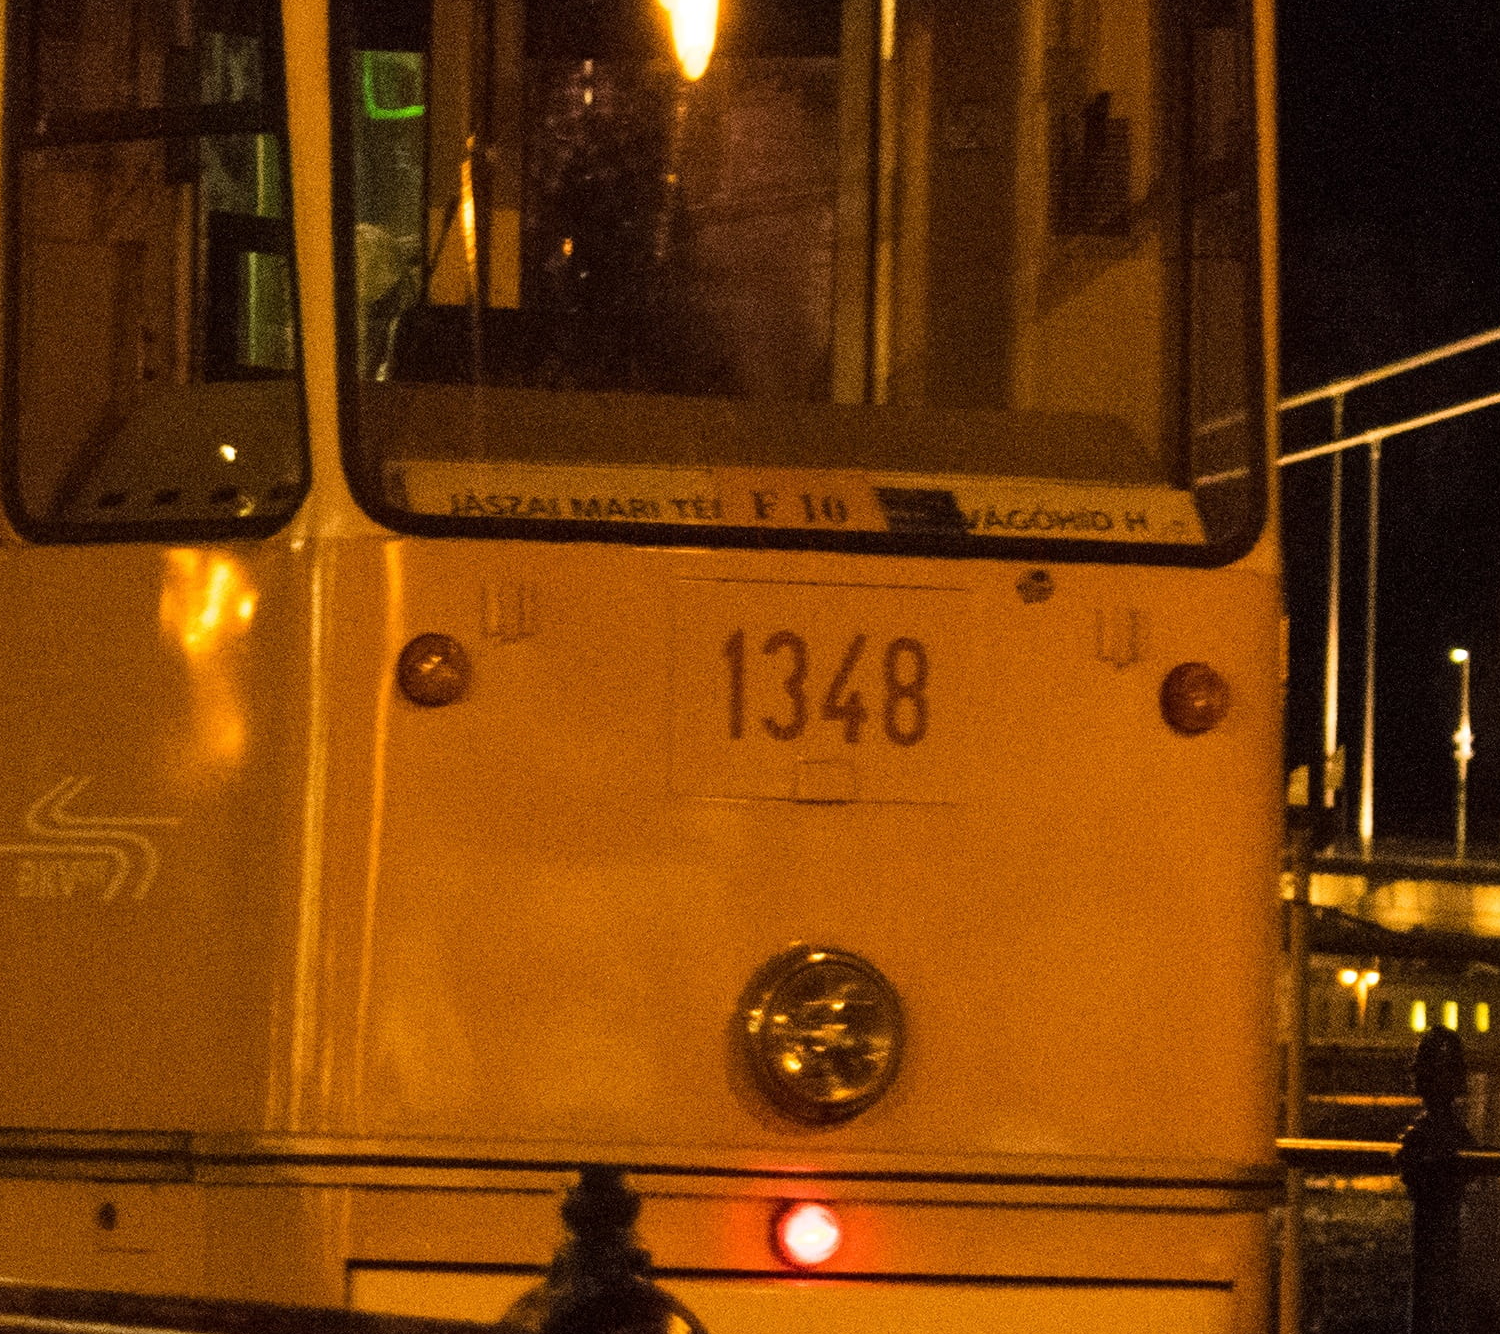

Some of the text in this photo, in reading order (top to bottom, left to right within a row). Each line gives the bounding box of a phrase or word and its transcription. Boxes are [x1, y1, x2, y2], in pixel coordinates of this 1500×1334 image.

[749, 488, 850, 524] F 10
[724, 628, 929, 748] 1348
